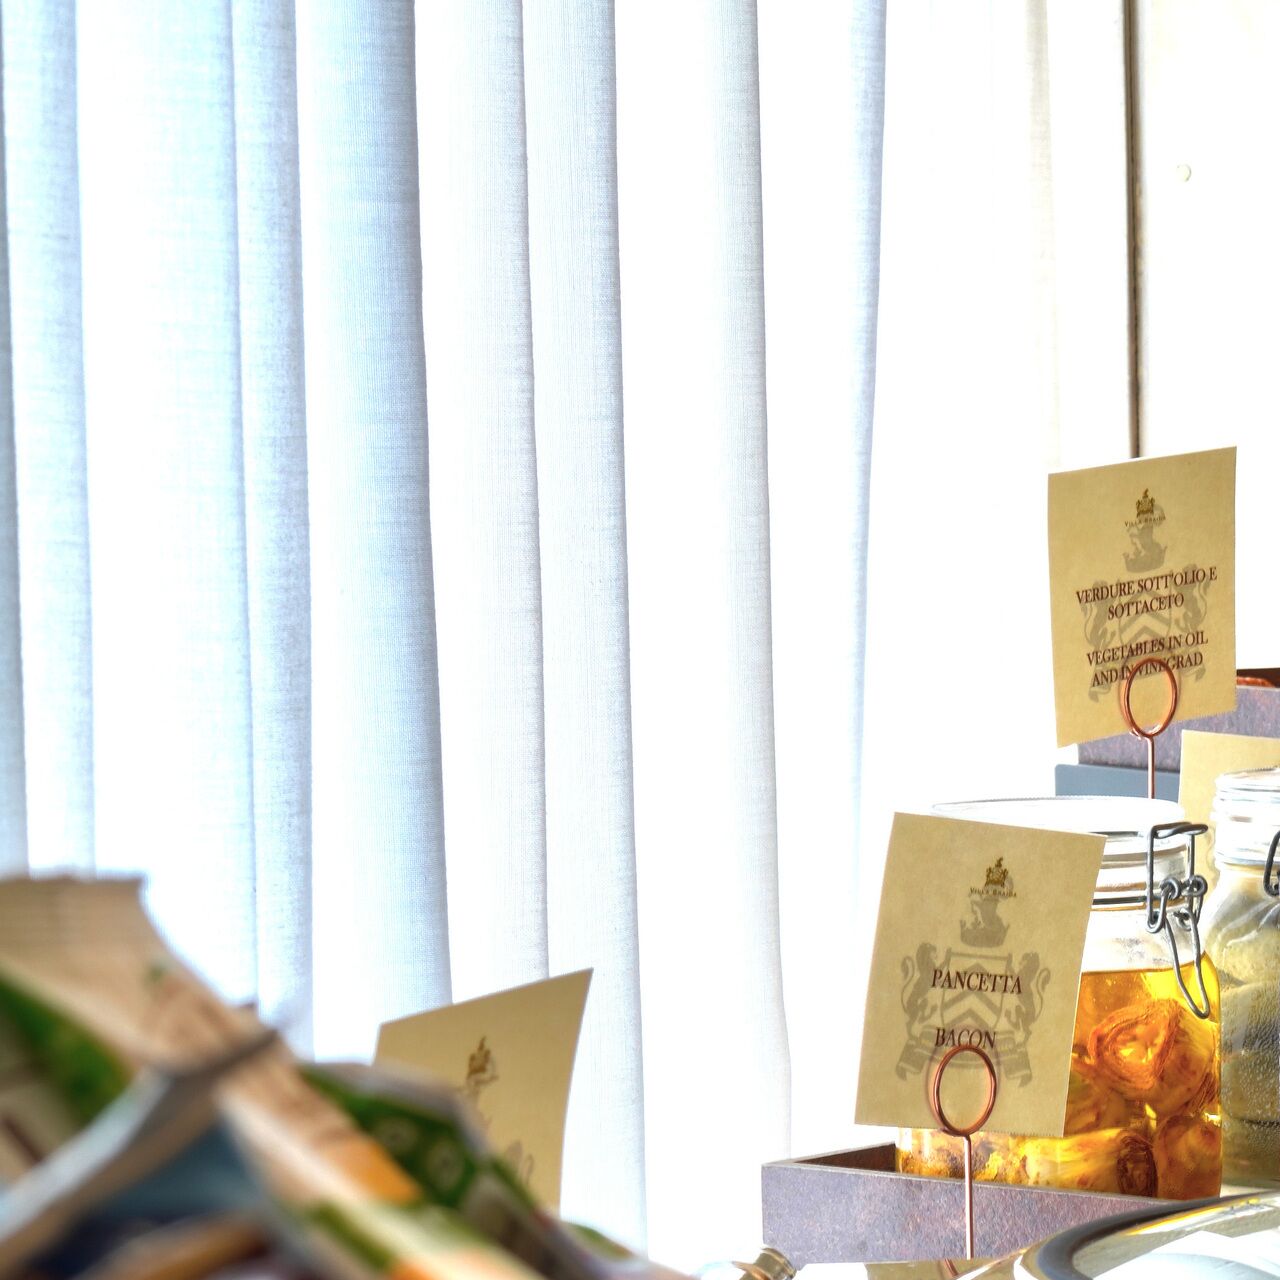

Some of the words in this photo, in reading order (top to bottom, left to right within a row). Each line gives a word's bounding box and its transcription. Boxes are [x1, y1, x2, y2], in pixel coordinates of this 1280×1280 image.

[1076, 582, 1135, 605] VERDURE
[1137, 568, 1206, 594] SOTT'OLIO
[1209, 566, 1218, 582] E
[1107, 593, 1185, 621] SOTTACETO
[1086, 637, 1165, 667] VEGETABLES
[1167, 634, 1182, 650] IN
[1185, 630, 1209, 646] OIL
[1092, 669, 1119, 688] AND
[931, 968, 1023, 995] PANCETTA
[934, 1026, 997, 1049] BACON
